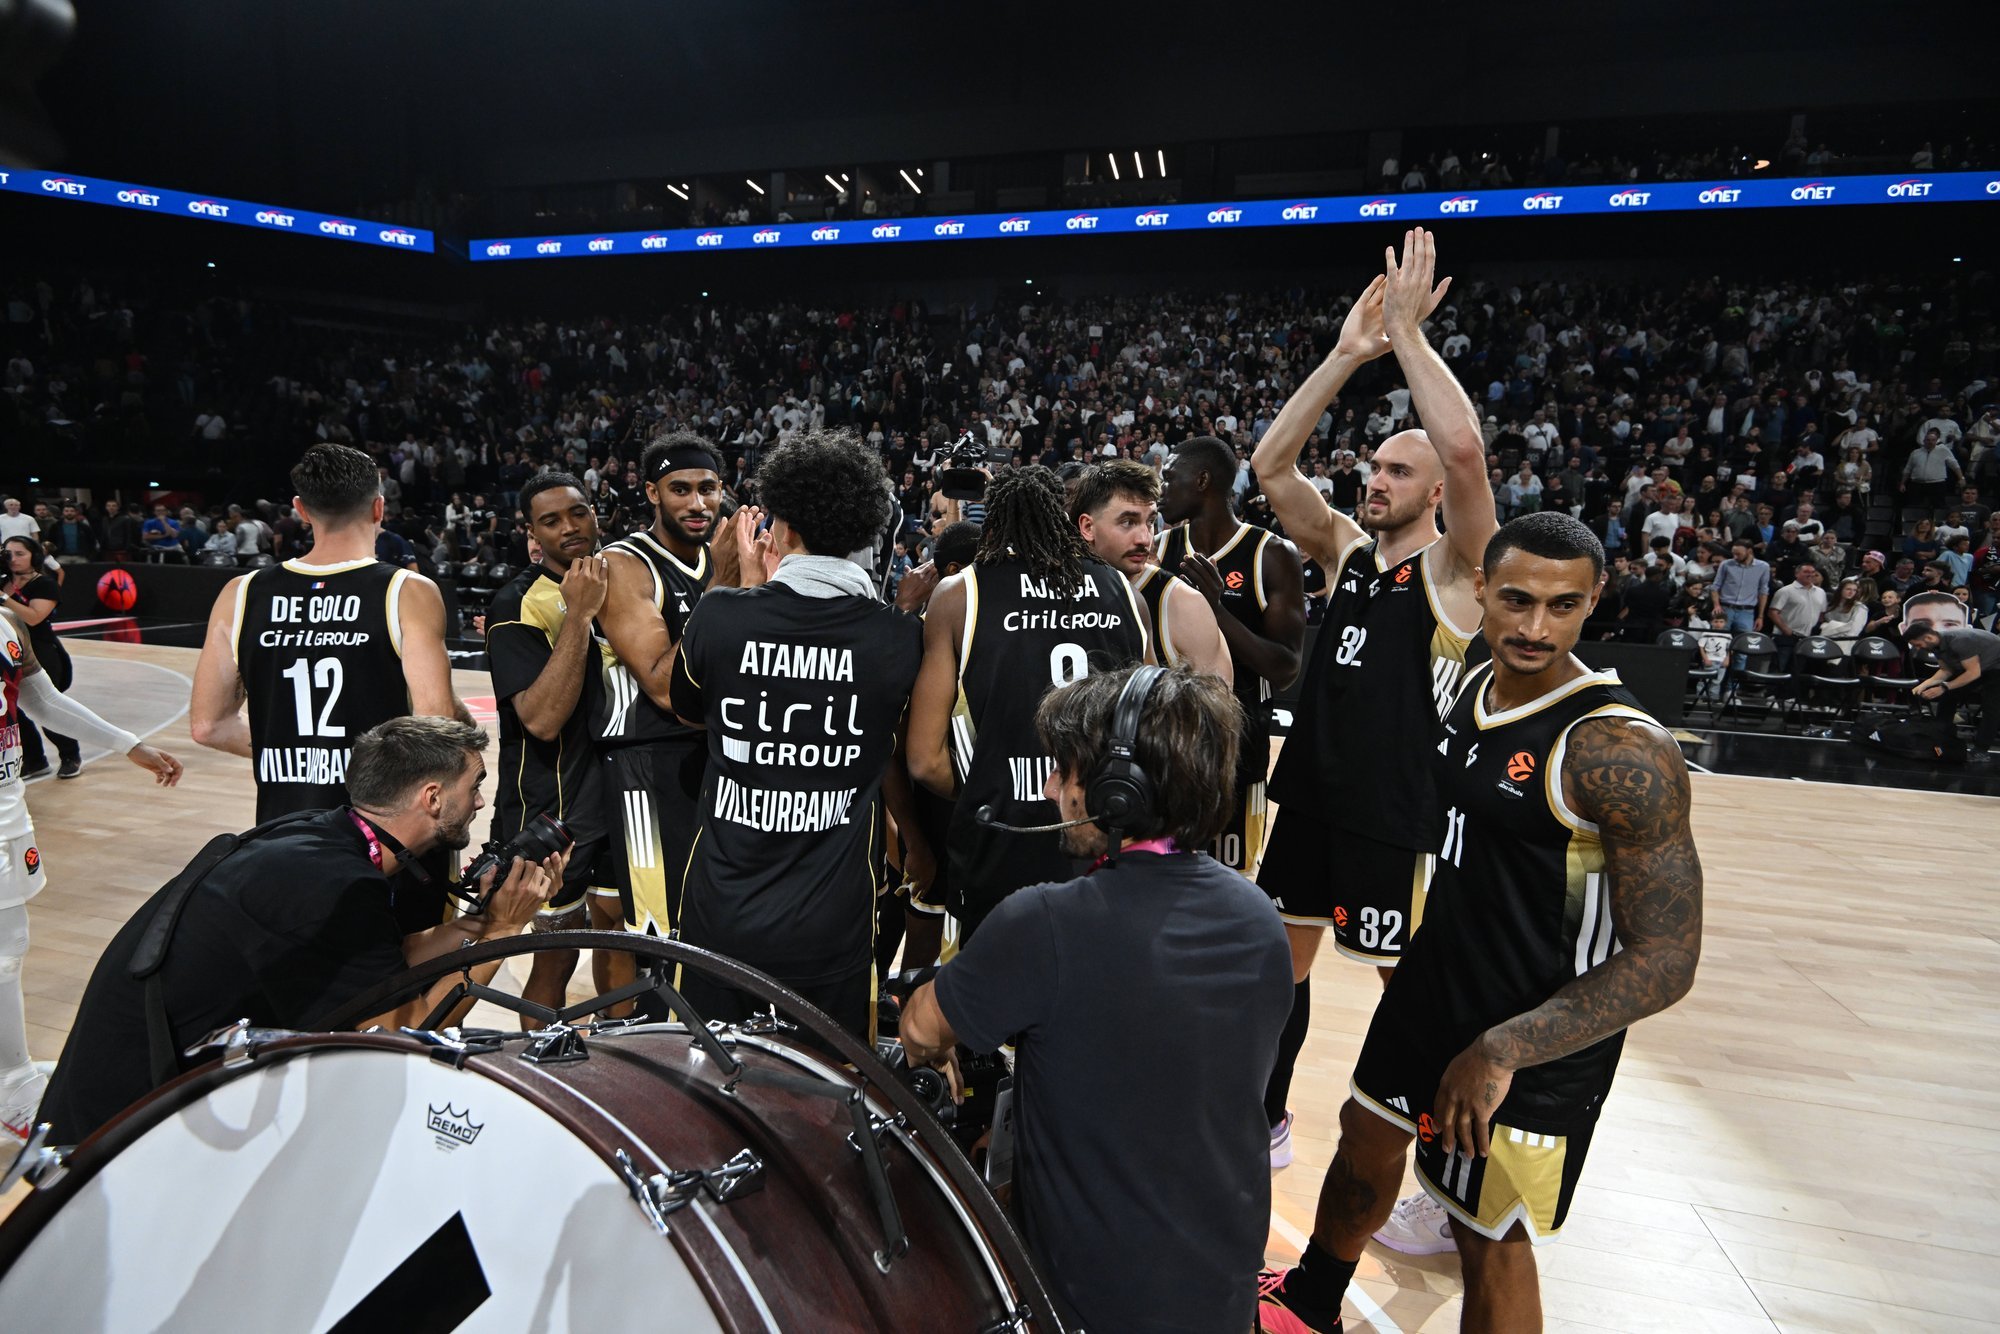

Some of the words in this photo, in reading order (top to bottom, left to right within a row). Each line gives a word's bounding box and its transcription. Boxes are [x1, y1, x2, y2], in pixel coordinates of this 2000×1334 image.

[41, 178, 87, 196] ONET
[117, 189, 160, 207] ONET
[188, 200, 230, 217] ONET
[255, 210, 295, 227] ONET
[319, 220, 357, 237] ONET
[379, 229, 416, 246] ONET
[486, 243, 511, 257] ONET
[536, 241, 562, 254] ONET
[588, 238, 614, 252] ONET
[641, 236, 668, 249] ONET
[696, 233, 723, 247] ONET
[752, 230, 781, 244] ONET
[811, 227, 840, 241] ONET
[871, 225, 902, 239] ONET
[934, 222, 965, 236] ONET
[999, 218, 1031, 233] ONET
[1066, 215, 1099, 230] ONET
[1135, 212, 1170, 227] ONET
[1207, 208, 1243, 224] ONET
[1281, 205, 1318, 220] ONET
[1359, 201, 1397, 217] ONET
[1439, 198, 1479, 214] ONET
[1522, 194, 1563, 210] ONET
[1609, 191, 1651, 207] ONET
[1698, 188, 1742, 204] ONET
[1790, 185, 1836, 201] ONET
[1886, 182, 1933, 197] ONET
[271, 595, 304, 623] DE
[308, 595, 361, 624] COLO
[739, 640, 854, 683] ATAMNA
[1050, 642, 1089, 689] 0
[1335, 625, 1367, 667] 32
[282, 656, 346, 738] 12
[720, 690, 864, 736] ciril
[755, 742, 861, 768] GROUP
[1008, 756, 1056, 802] VILL
[714, 775, 858, 832] VILLEURBANNE
[1213, 832, 1240, 867] 10
[1440, 806, 1466, 868] 11
[1359, 906, 1403, 951] 32
[431, 1115, 473, 1140] REMO
